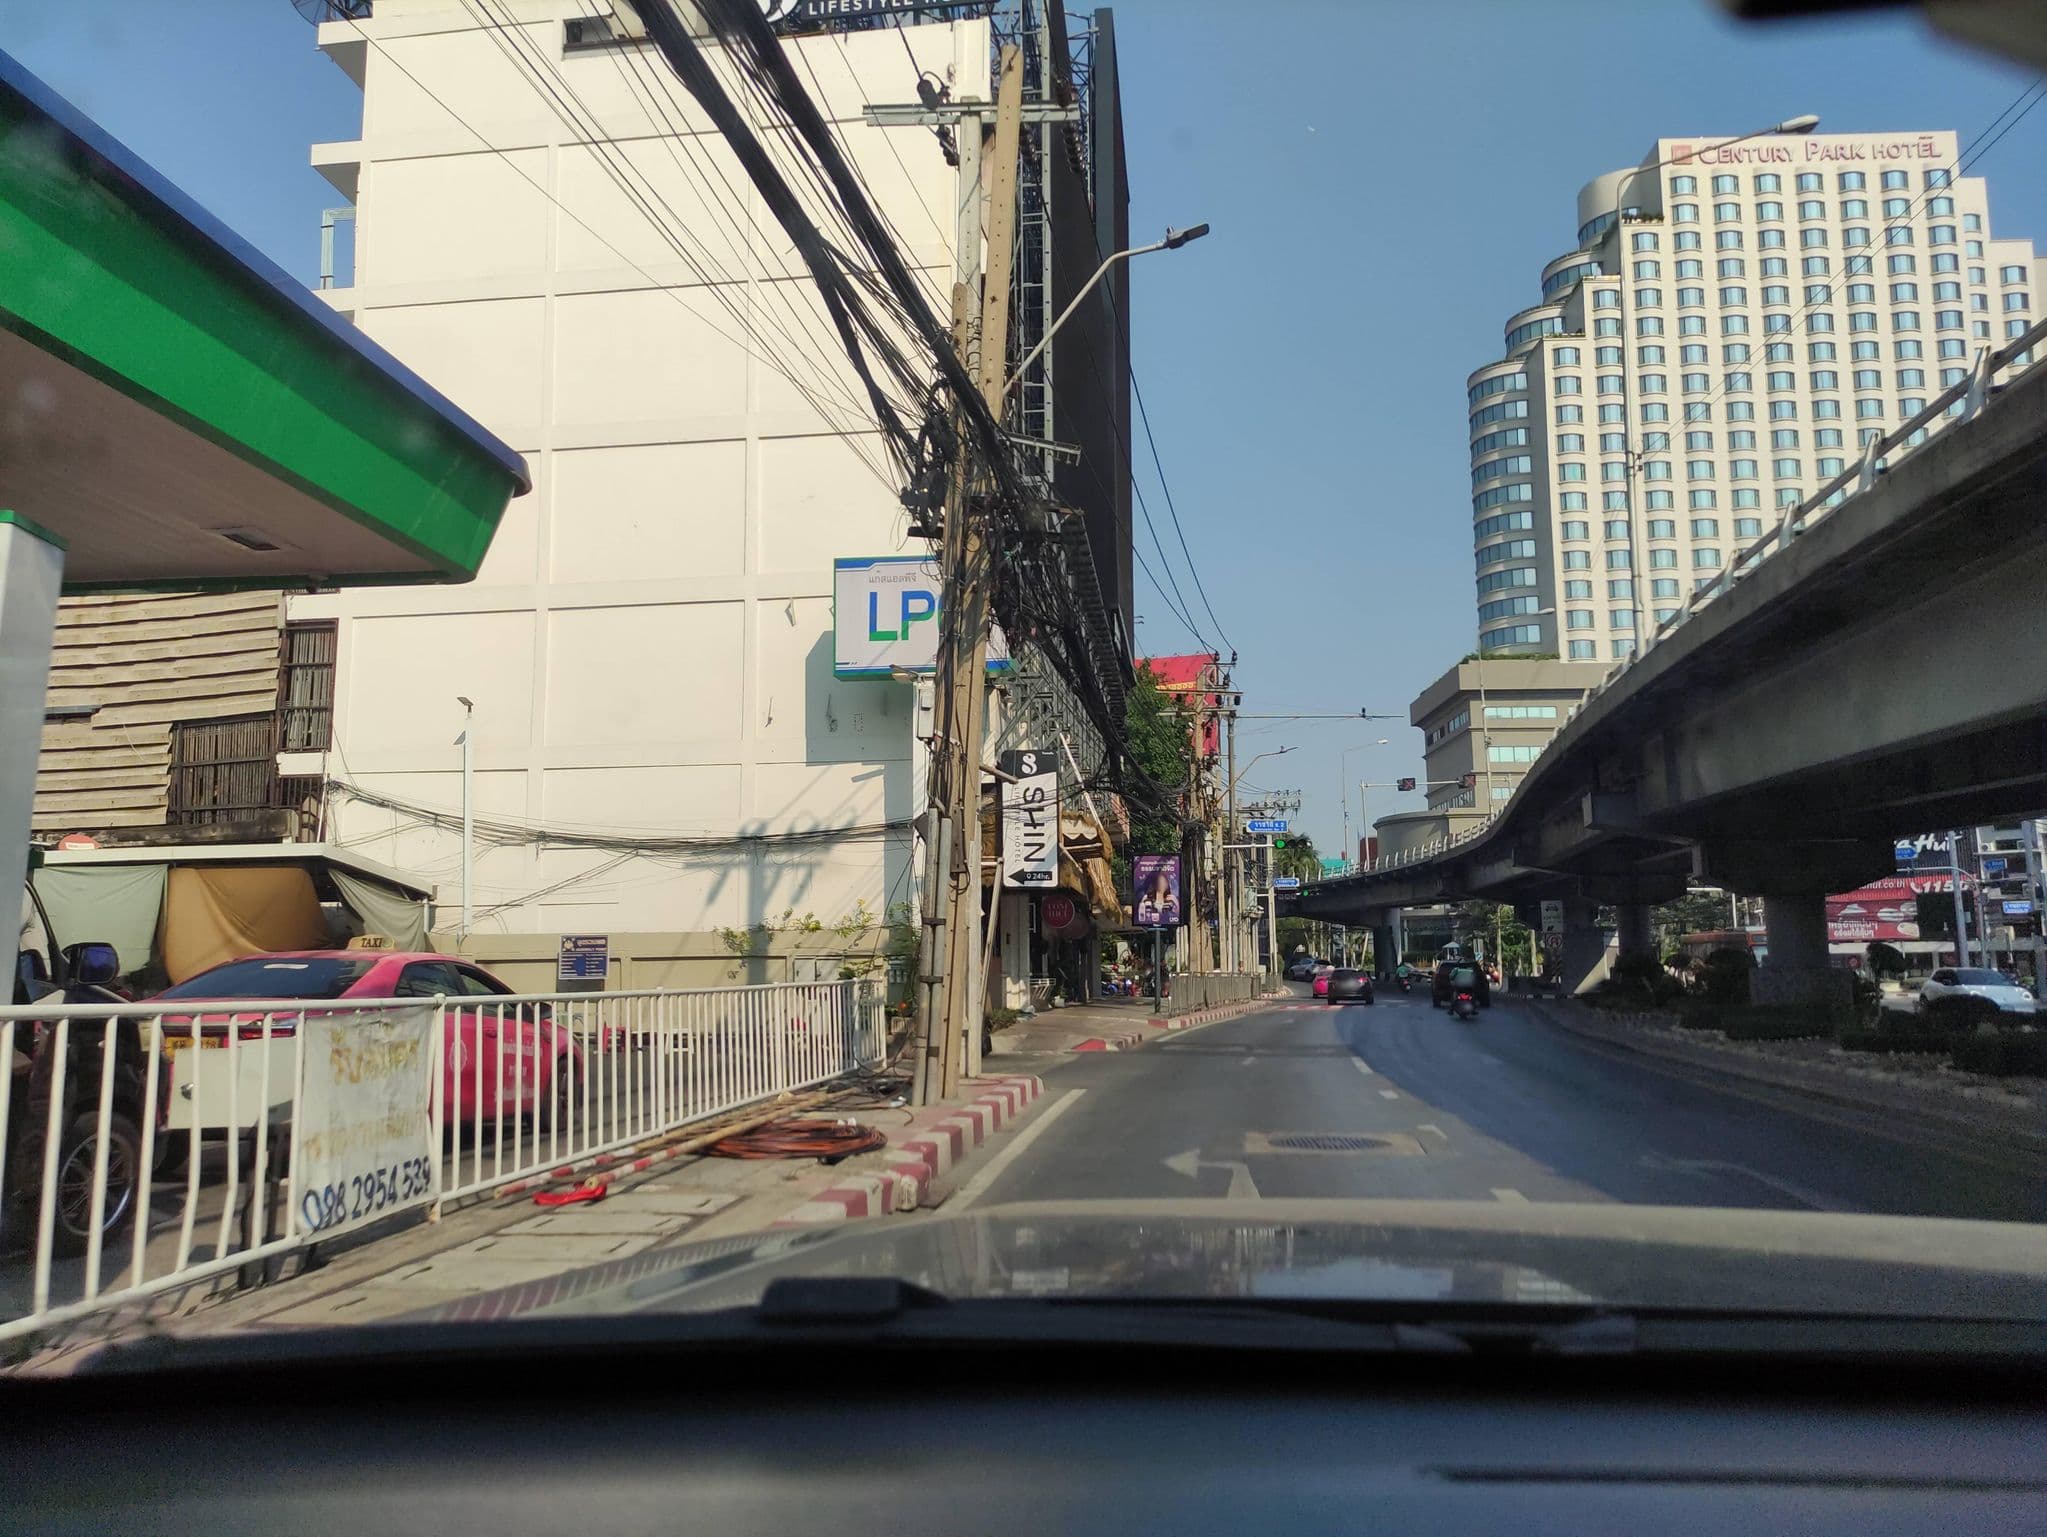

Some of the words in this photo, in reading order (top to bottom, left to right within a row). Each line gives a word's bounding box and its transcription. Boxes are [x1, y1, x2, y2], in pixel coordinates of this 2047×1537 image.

[1699, 145, 1795, 165] CENTURY
[1804, 139, 1868, 162] PARK
[1871, 141, 1942, 160] HOTEL
[868, 589, 944, 642] LP
[1022, 786, 1046, 862] SHIN
[361, 937, 384, 948] TAXI
[351, 1164, 398, 1220] 2954
[402, 1155, 431, 1200] 539
